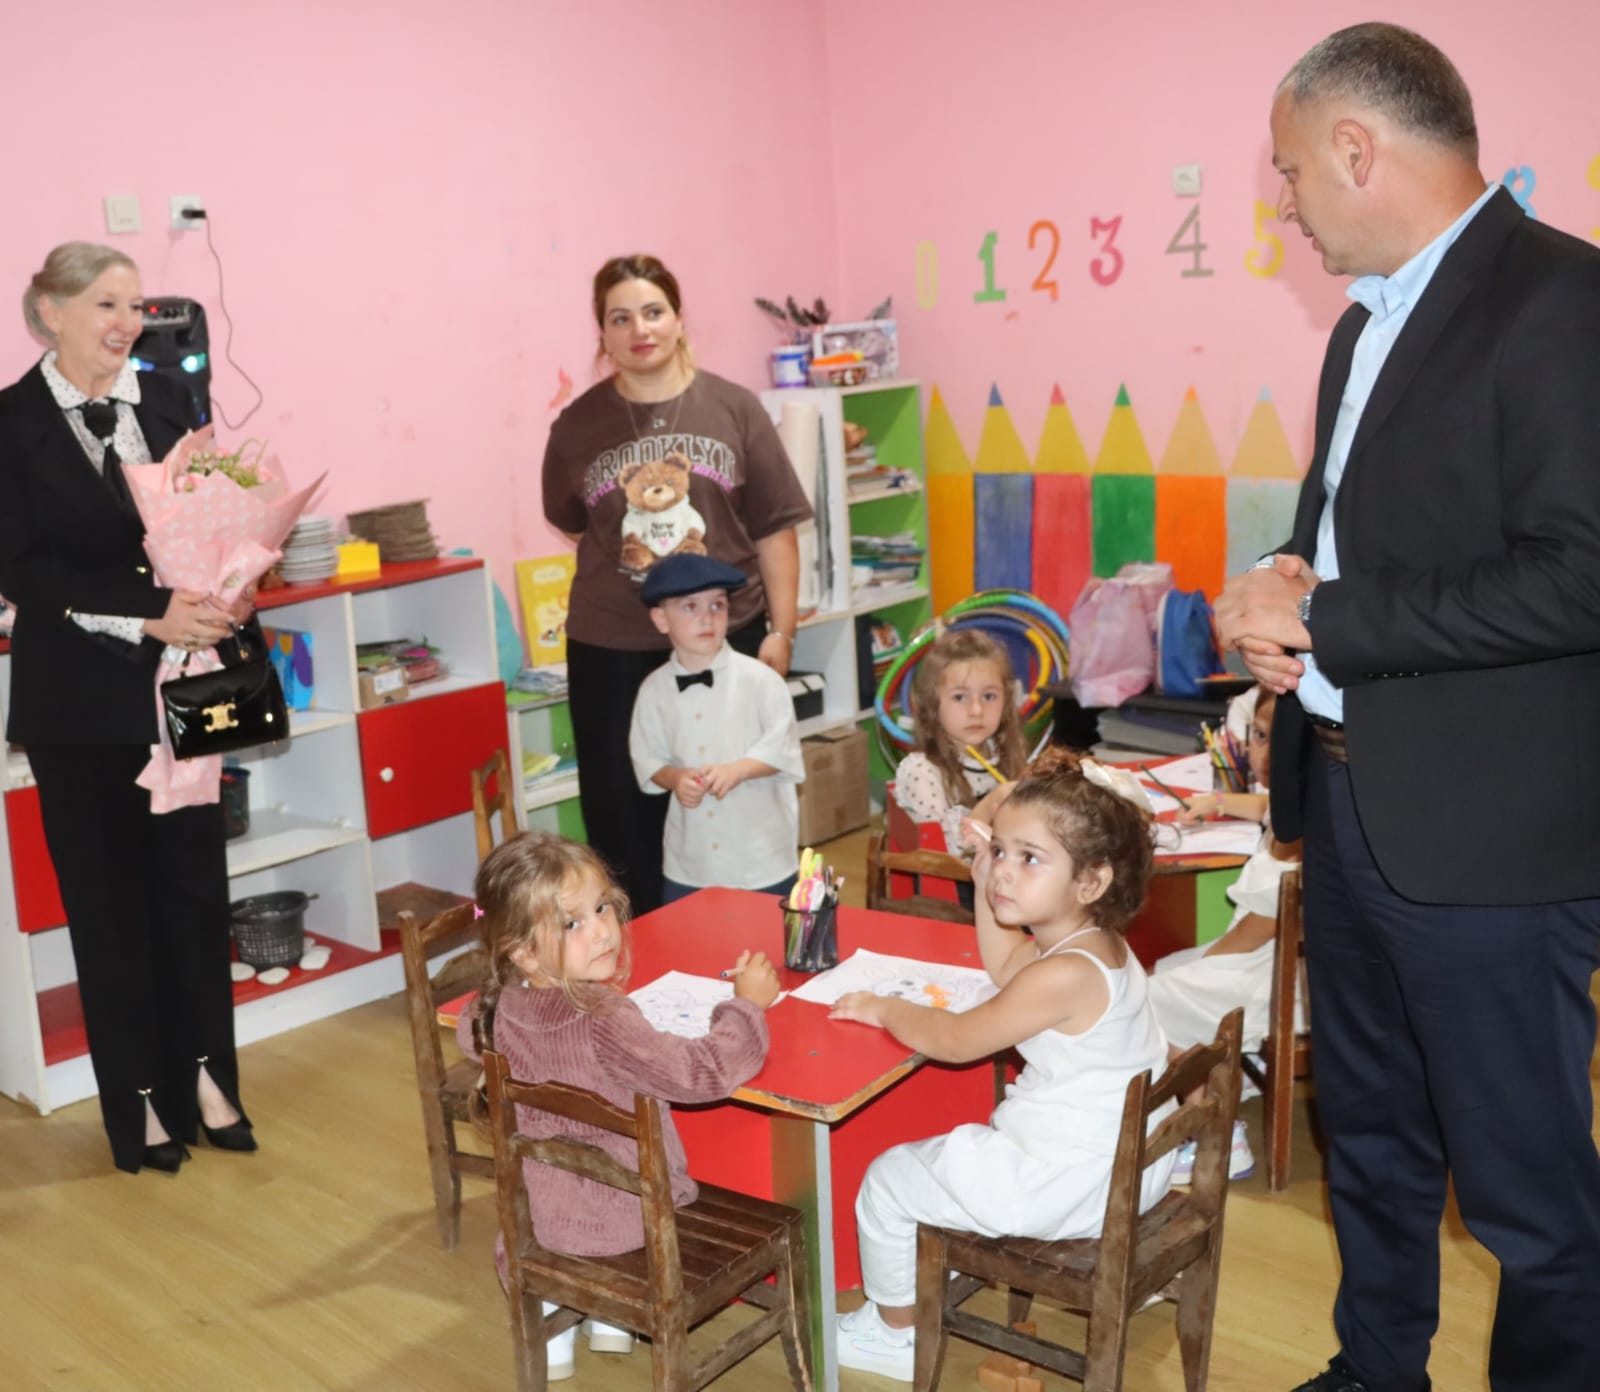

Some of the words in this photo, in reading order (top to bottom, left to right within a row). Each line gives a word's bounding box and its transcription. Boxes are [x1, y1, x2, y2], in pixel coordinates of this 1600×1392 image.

[973, 230, 1006, 303] 1
[1028, 219, 1060, 302] 2
[1090, 215, 1124, 286] 3
[1164, 203, 1214, 278] 4
[1243, 200, 1285, 278] 5
